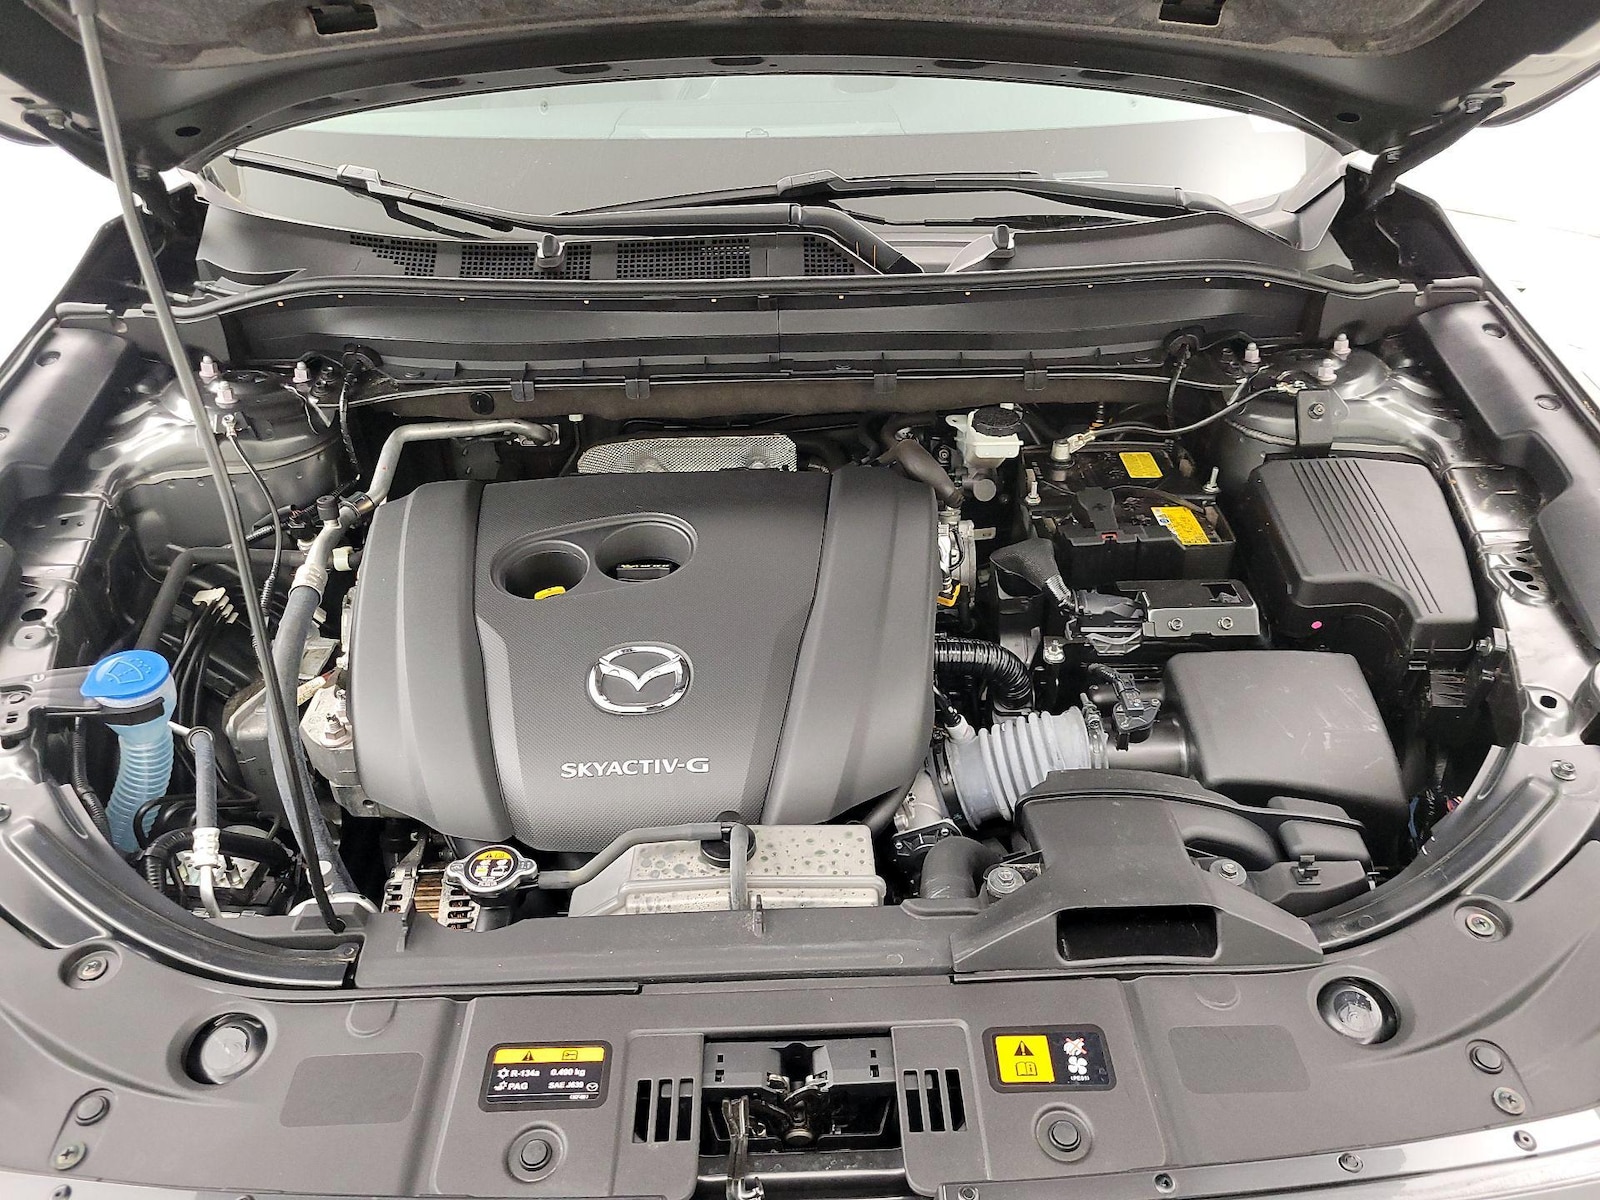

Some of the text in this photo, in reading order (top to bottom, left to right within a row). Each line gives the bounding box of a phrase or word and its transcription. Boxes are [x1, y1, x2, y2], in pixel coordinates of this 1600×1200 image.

[560, 757, 710, 778] SKYACTIV-G
[509, 1068, 541, 1078] R-134a
[574, 1067, 586, 1077] kg
[507, 1081, 529, 1091] PAG
[547, 1081, 566, 1089] SAE
